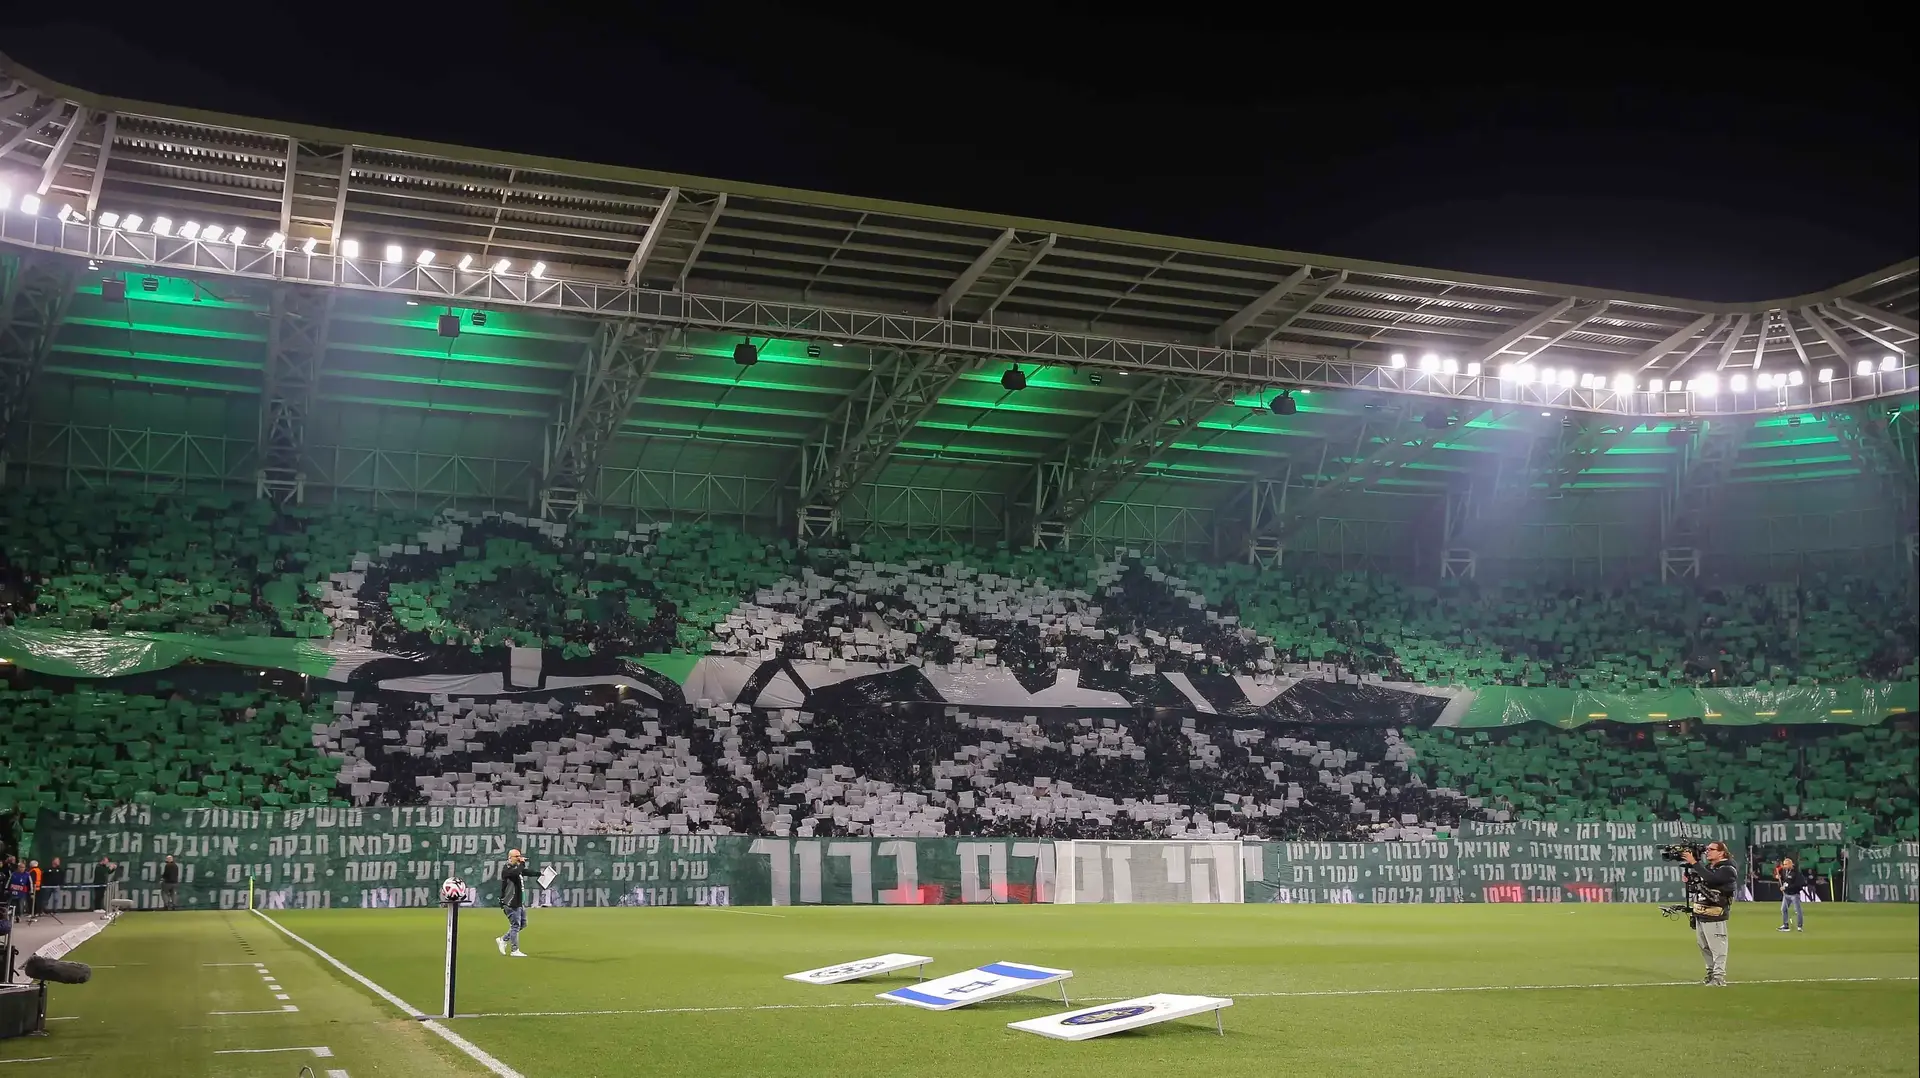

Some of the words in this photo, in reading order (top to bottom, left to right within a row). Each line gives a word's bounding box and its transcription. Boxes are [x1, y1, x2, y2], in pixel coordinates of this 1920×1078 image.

[110, 803, 151, 825] גיא
[283, 807, 363, 830] מושיקו
[392, 807, 444, 828] עבדו
[454, 807, 500, 828] נועם
[1576, 822, 1600, 841] דגן
[1606, 822, 1636, 841] אסף
[1715, 823, 1736, 841] רון
[1753, 823, 1787, 846] מגן
[1795, 823, 1842, 841] אביב
[67, 830, 143, 857] גנדלין
[268, 834, 329, 859] חבקה
[339, 832, 412, 858] סלמאן
[441, 833, 507, 855] צרפתי
[516, 834, 578, 855] אופיר
[606, 835, 660, 856] פישר
[669, 835, 717, 854] אמיר
[1285, 841, 1332, 862] סלימן
[1338, 842, 1365, 860] נדב
[1384, 839, 1449, 862] סילברמן
[1453, 837, 1510, 859] אוריאל
[1529, 841, 1601, 861] אבוחצירה
[1607, 843, 1653, 862] אוראל
[226, 863, 272, 883] וייס
[282, 862, 316, 884] בני
[345, 860, 398, 881] משה
[407, 860, 456, 880] רועי
[611, 860, 660, 881] ברנס
[669, 858, 709, 880] שלו
[748, 838, 925, 906] ברוך
[1292, 865, 1314, 883] רם
[1319, 864, 1359, 883] עמרי
[1378, 864, 1422, 882] סעידי
[1428, 864, 1454, 881] צור
[1472, 863, 1505, 881] הלוי
[1510, 862, 1556, 881] אביעד
[1871, 862, 1891, 880] לוי
[208, 887, 285, 910] אלפסי
[360, 886, 430, 908] אוחיון
[563, 888, 611, 908] איתי
[1322, 887, 1353, 904] מאי
[1429, 886, 1465, 904] איתי
[1482, 886, 1522, 904] היימן
[1527, 885, 1562, 904] ענבר
[1619, 886, 1660, 903] דניאל
